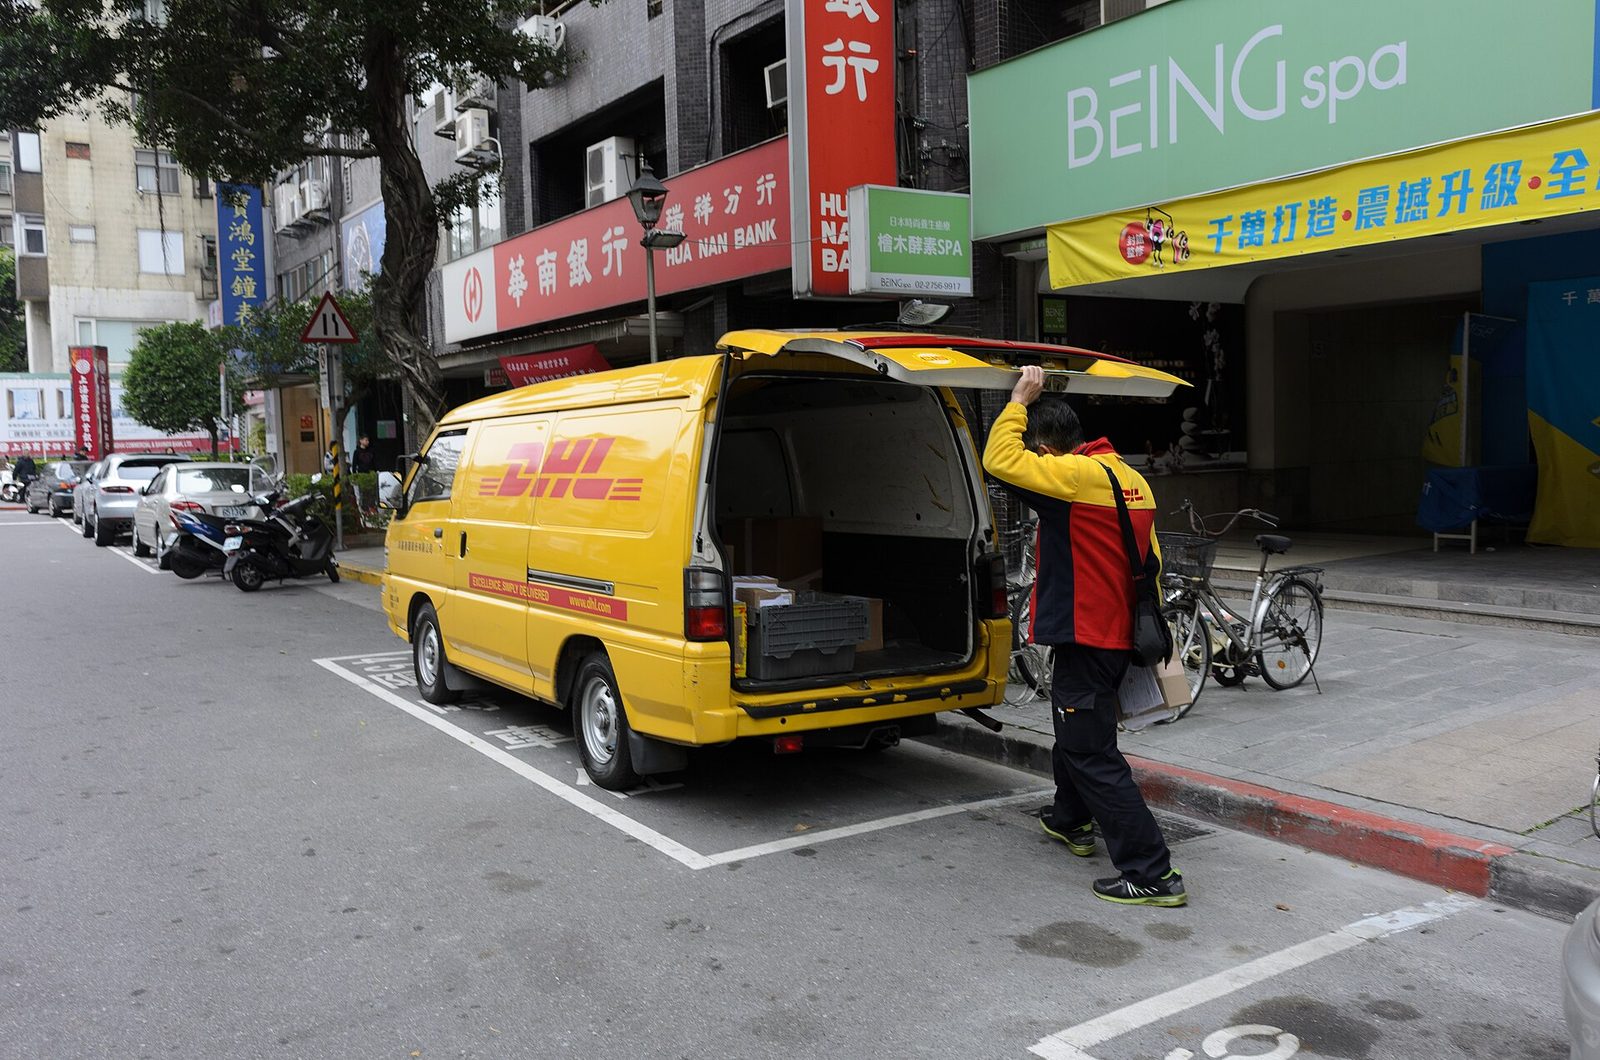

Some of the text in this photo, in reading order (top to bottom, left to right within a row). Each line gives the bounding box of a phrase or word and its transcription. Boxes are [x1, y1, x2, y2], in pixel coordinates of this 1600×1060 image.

[1068, 24, 1407, 170] BEING spa
[665, 173, 777, 232] 瑞祥分行
[820, 192, 848, 217] HU
[1207, 147, 1600, 254] 千萬打造 震撼升級 全
[666, 218, 777, 267] HUA NAN BANK
[821, 221, 849, 245] NA
[507, 225, 628, 308] 華南銀行
[822, 248, 849, 273] BA
[497, 437, 616, 501] DHL
[519, 584, 550, 602] DELIVERED
[568, 595, 612, 614] www.dhl.com
